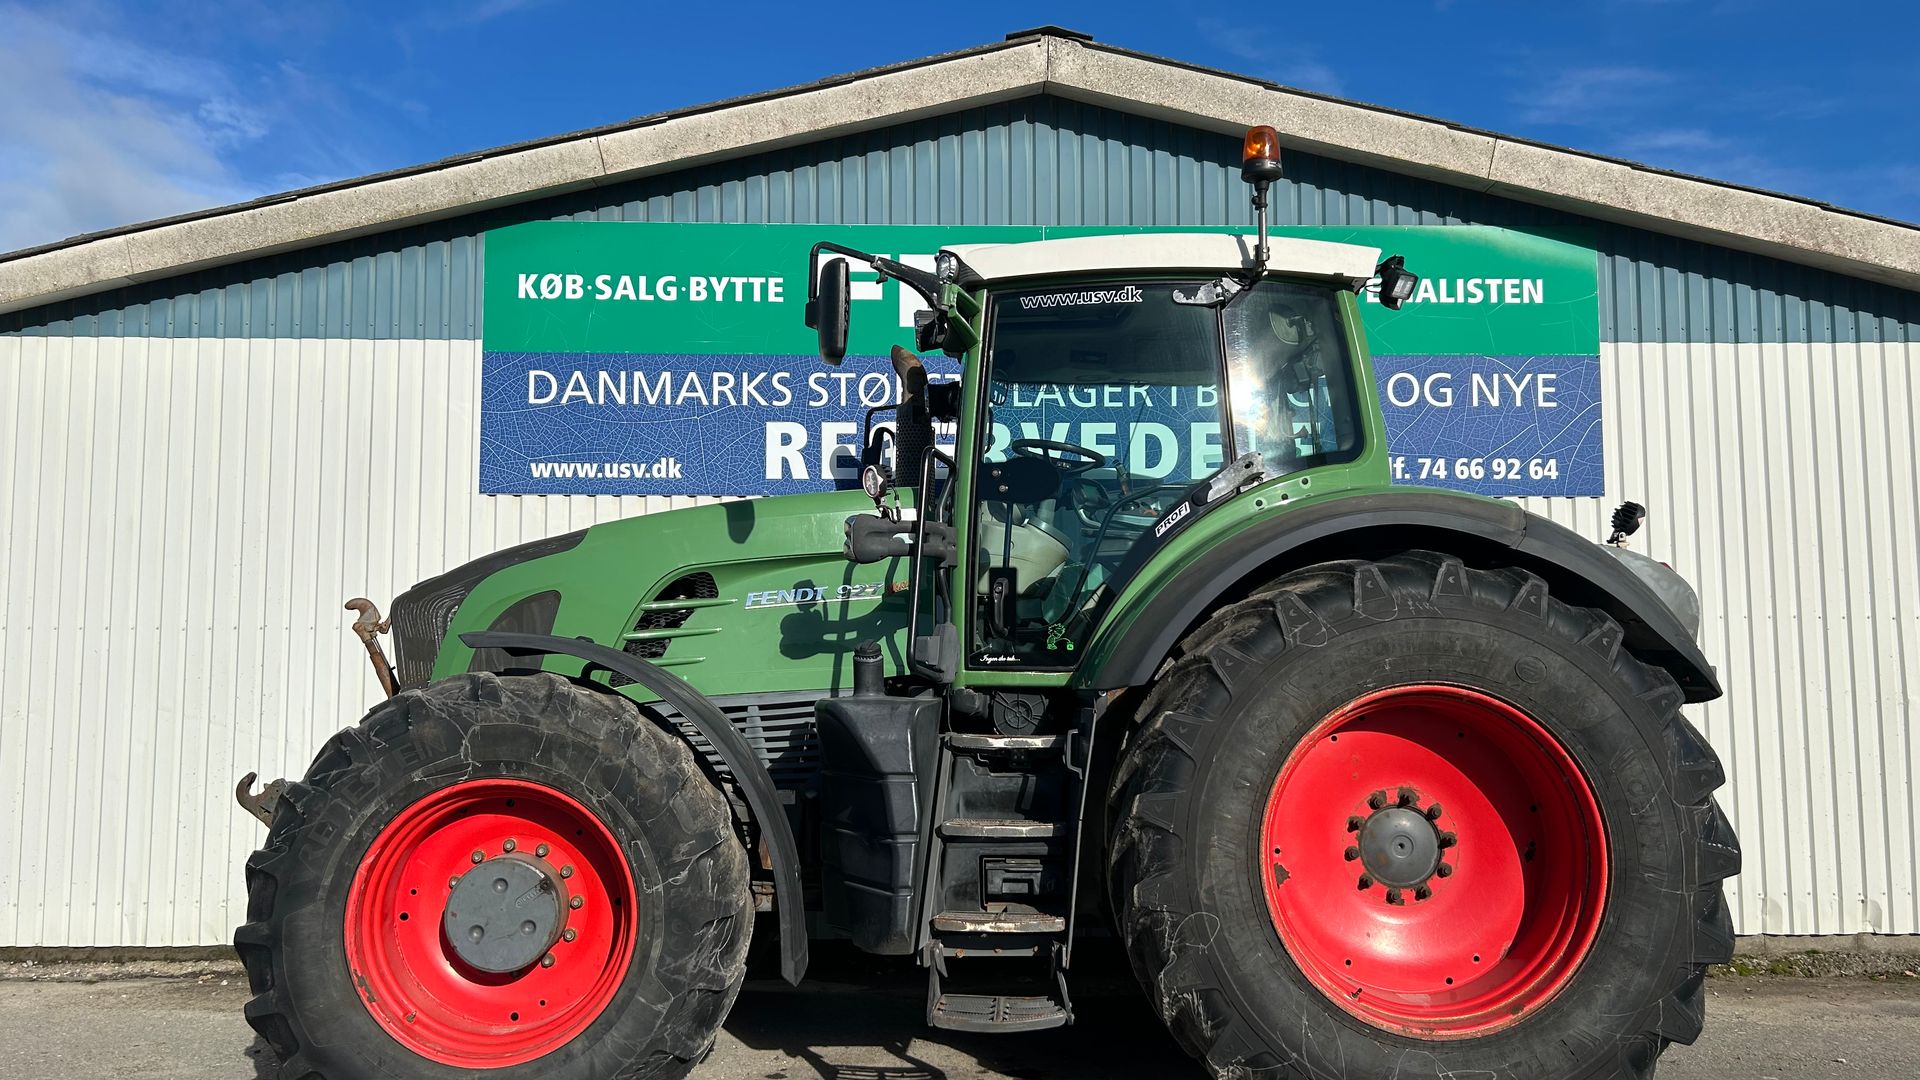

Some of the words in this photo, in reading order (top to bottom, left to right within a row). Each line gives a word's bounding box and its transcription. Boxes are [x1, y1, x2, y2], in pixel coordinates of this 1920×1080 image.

[1020, 286, 1142, 309] www.usv.dk
[1366, 278, 1545, 304] EALISTEN
[528, 371, 792, 407] DANMARKS
[1387, 373, 1452, 407] OG
[1473, 374, 1557, 407] NYE
[530, 458, 682, 479] www.usv.dk
[1417, 458, 1448, 479] 74
[1454, 458, 1485, 480] 66
[1492, 458, 1521, 480] 92
[1529, 458, 1559, 480] 64
[1157, 502, 1189, 535] PROFI
[746, 586, 828, 606] FENDT
[836, 583, 884, 599] 927
